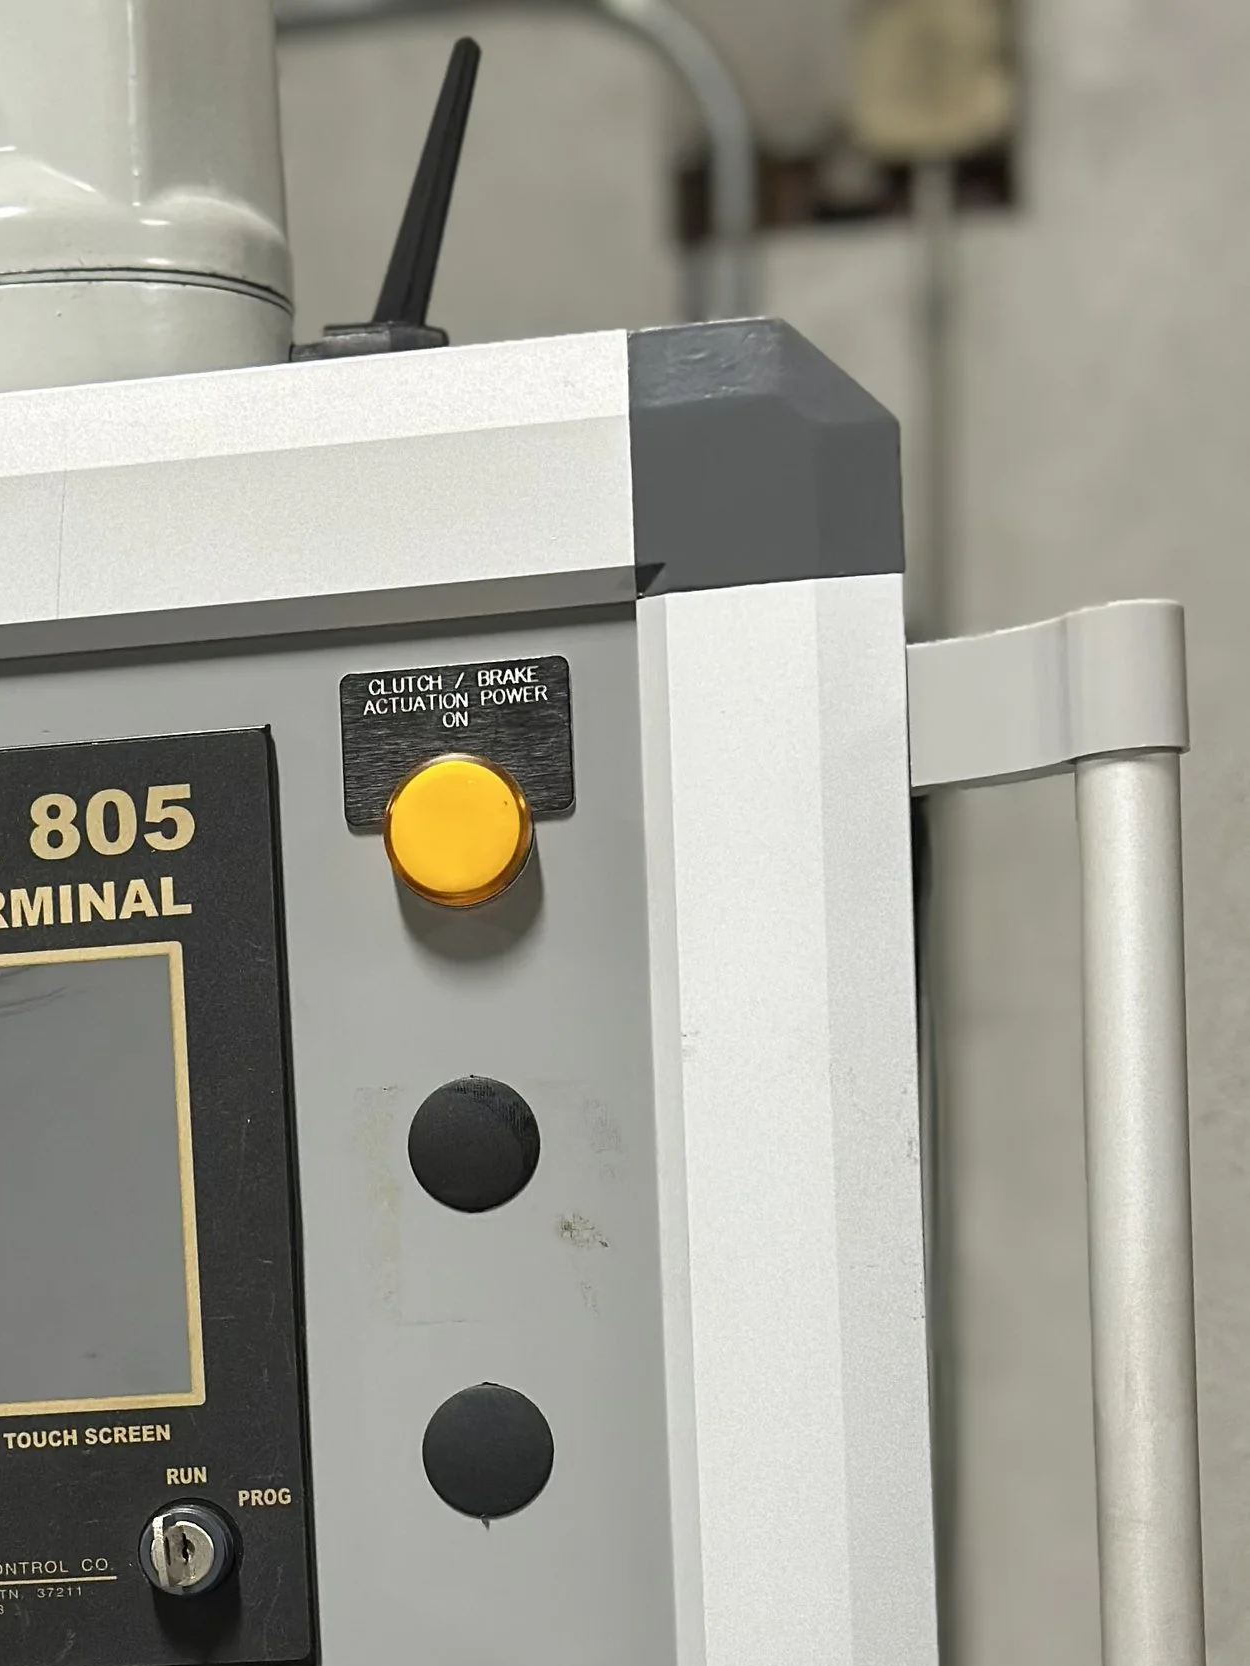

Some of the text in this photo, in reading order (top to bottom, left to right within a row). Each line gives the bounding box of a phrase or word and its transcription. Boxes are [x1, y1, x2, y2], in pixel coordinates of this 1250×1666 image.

[368, 666, 539, 696] CLUTCH / BRAKE
[363, 685, 548, 716] ACTUATION POWER
[442, 711, 469, 728] ON
[29, 783, 196, 860] 805
[3, 1429, 78, 1449] TOUCH
[85, 1424, 171, 1445] SCREEN
[166, 1466, 208, 1485] RUN
[238, 1488, 292, 1507] PROG
[81, 1557, 114, 1572] CO.
[37, 1586, 82, 1599] 37211
